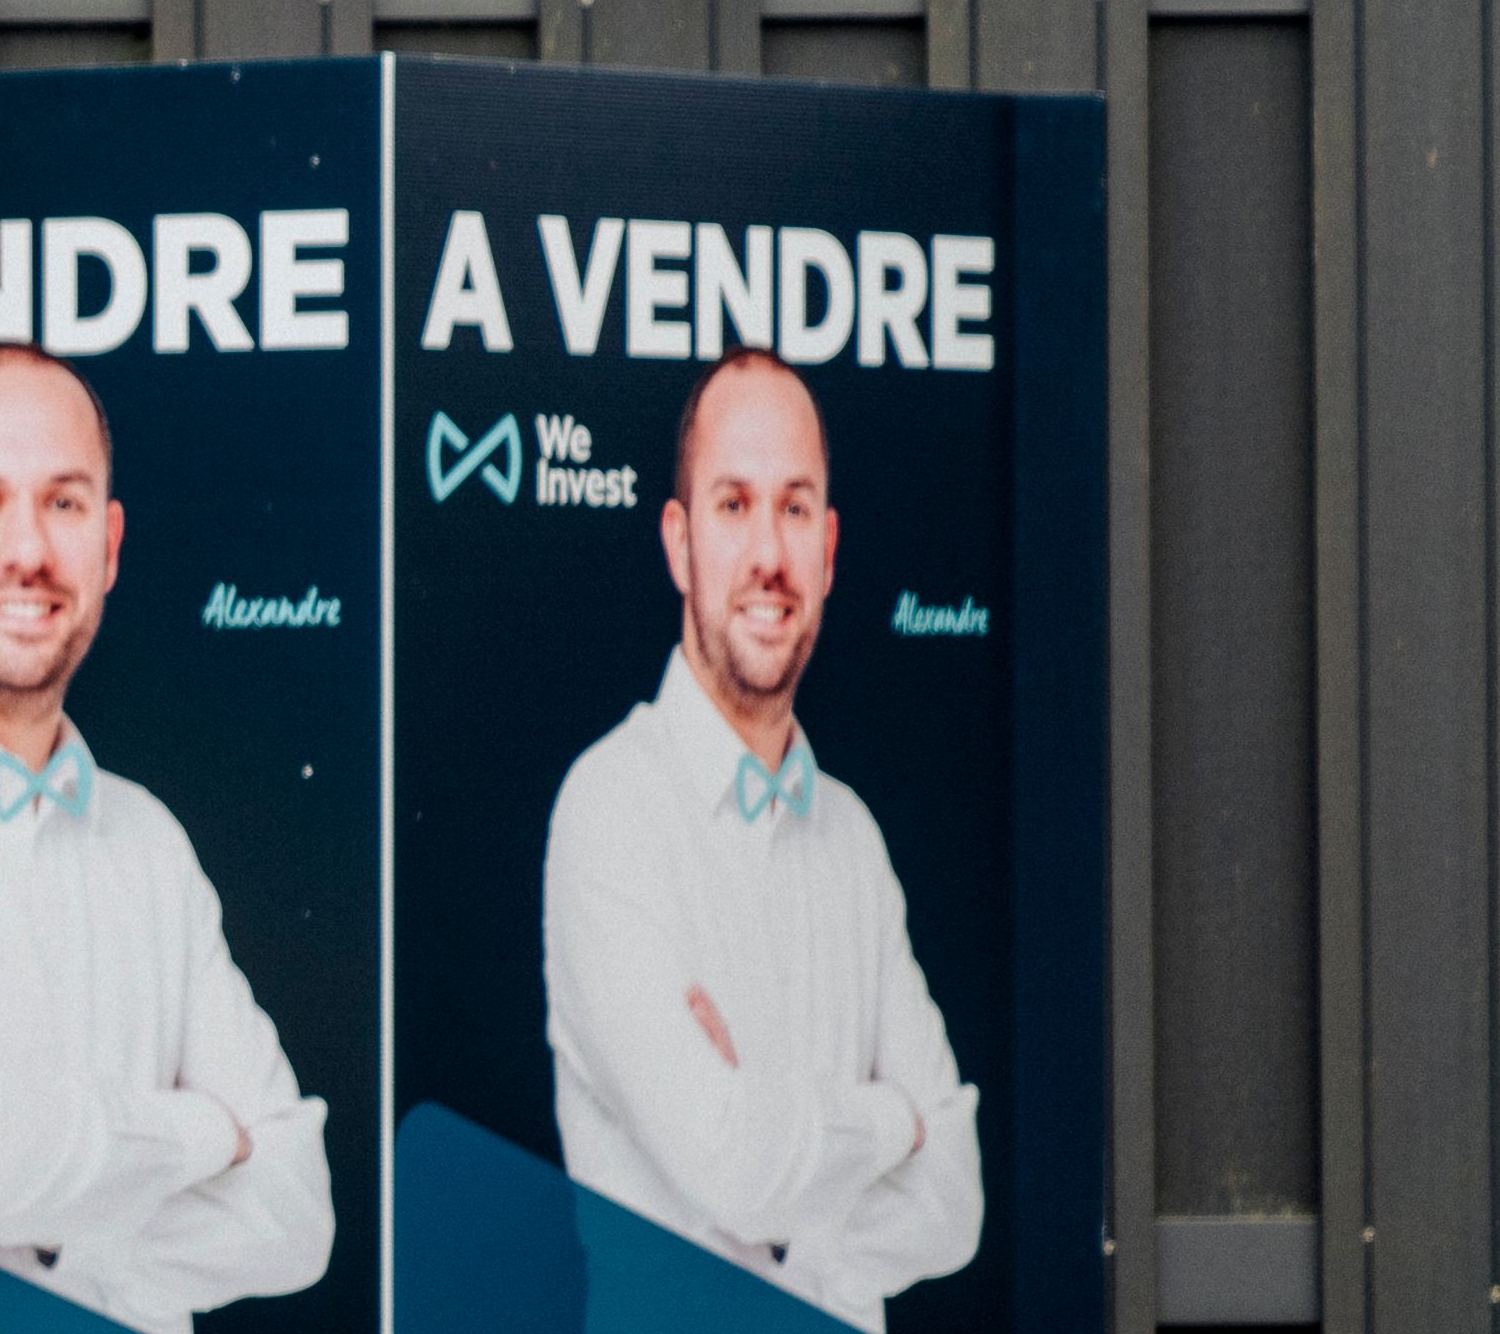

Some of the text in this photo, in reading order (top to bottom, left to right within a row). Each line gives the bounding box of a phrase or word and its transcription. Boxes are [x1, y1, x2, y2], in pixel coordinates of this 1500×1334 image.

[422, 210, 994, 370] A VENDRE
[535, 414, 592, 464] We
[536, 457, 638, 507] Invest
[201, 581, 342, 630] Alexandre
[892, 590, 989, 636] Alexandre
